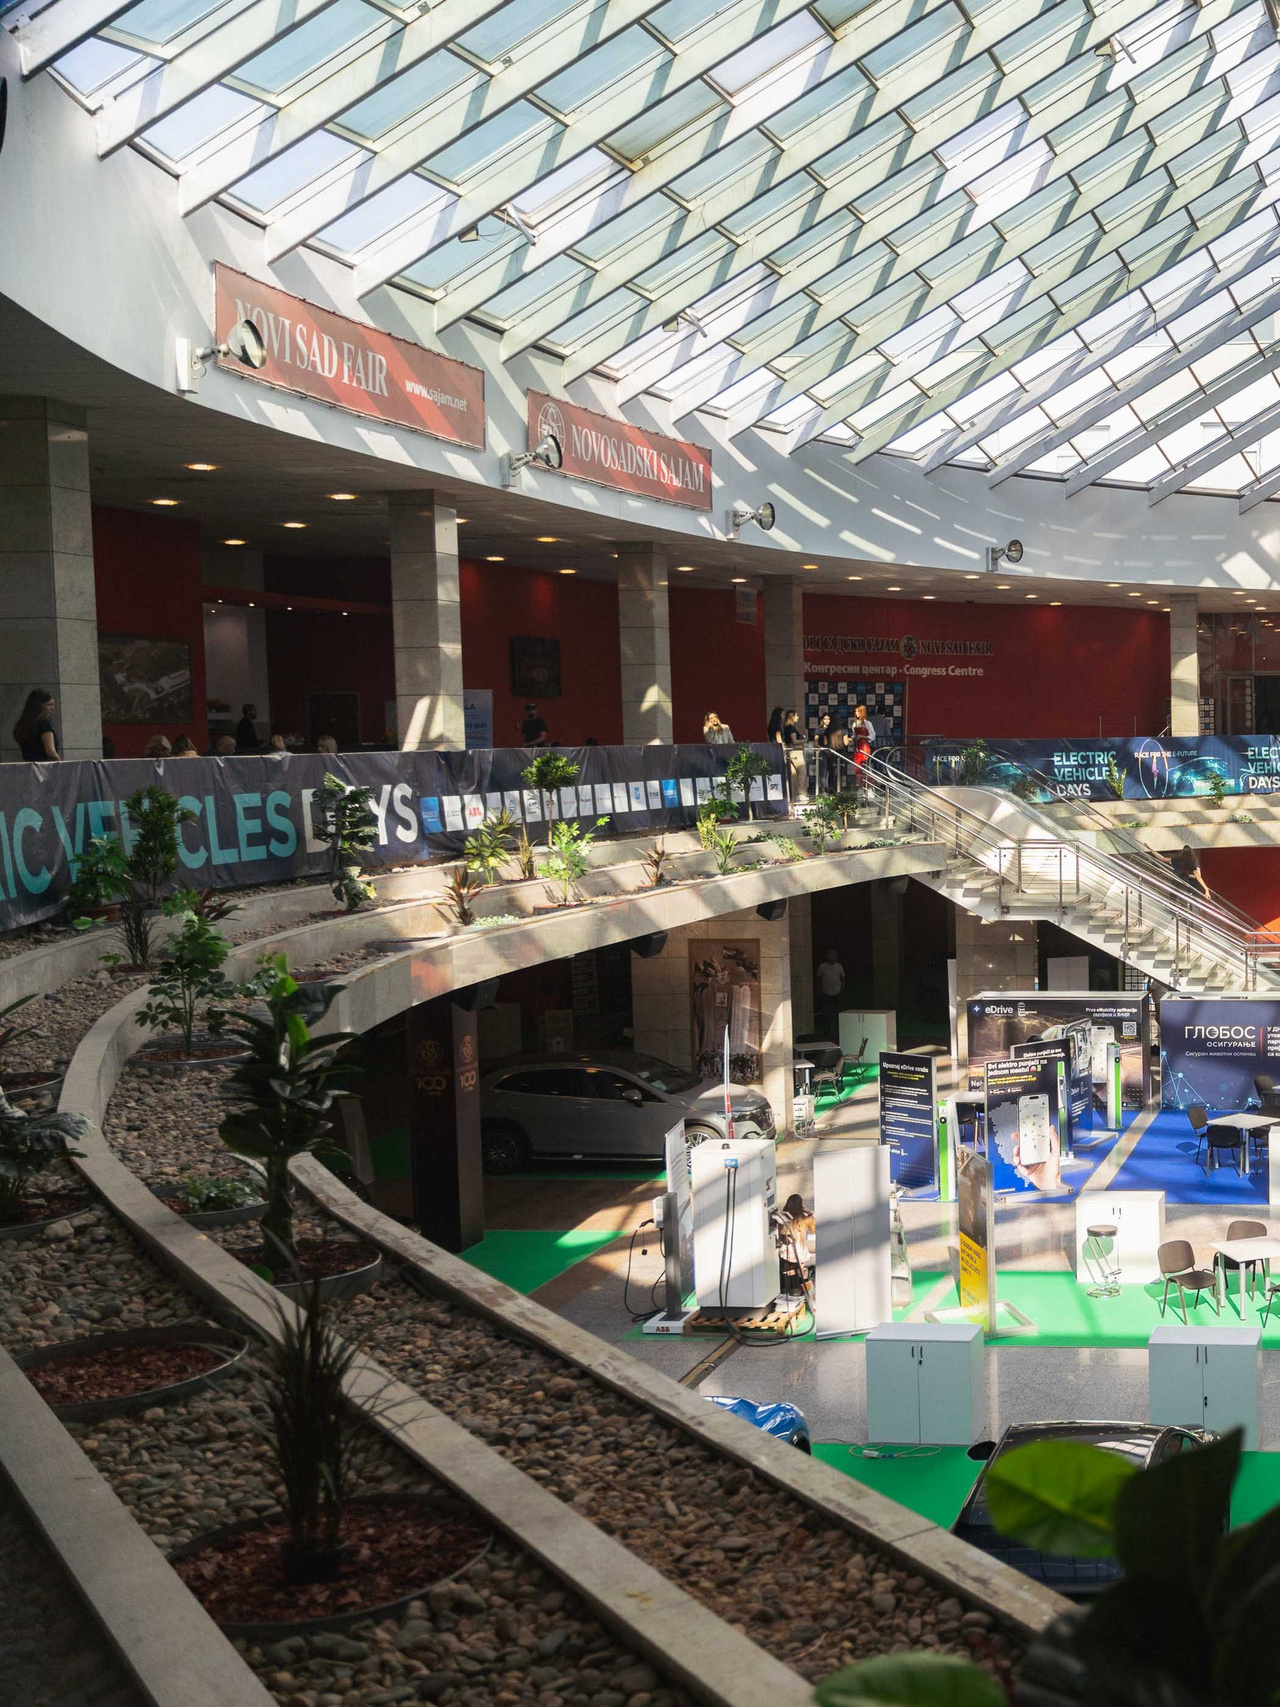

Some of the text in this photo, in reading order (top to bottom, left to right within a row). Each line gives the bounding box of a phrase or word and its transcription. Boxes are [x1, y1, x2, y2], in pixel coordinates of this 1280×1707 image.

[296, 324, 337, 379] SAD
[342, 342, 388, 397] FAIR
[405, 380, 467, 412] www.sajam.net
[571, 424, 704, 492] NOVOSADSKI SAJAM
[919, 640, 994, 656] NOVI SAD FAIR
[804, 662, 897, 677] Конгресни центар
[904, 664, 984, 678] Congress Centre
[933, 755, 948, 763] RACE
[1054, 751, 1116, 766] ELECTRIC
[1134, 751, 1149, 759] RACE
[1172, 750, 1198, 758] E-FUTURE
[1249, 776, 1280, 789] DAYS
[1057, 783, 1091, 797] DAYS
[985, 1005, 1014, 1014] eDrive
[1185, 1026, 1256, 1039] ГЛОБОС
[1018, 1059, 1040, 1068] punjači
[460, 1070, 477, 1088] 100
